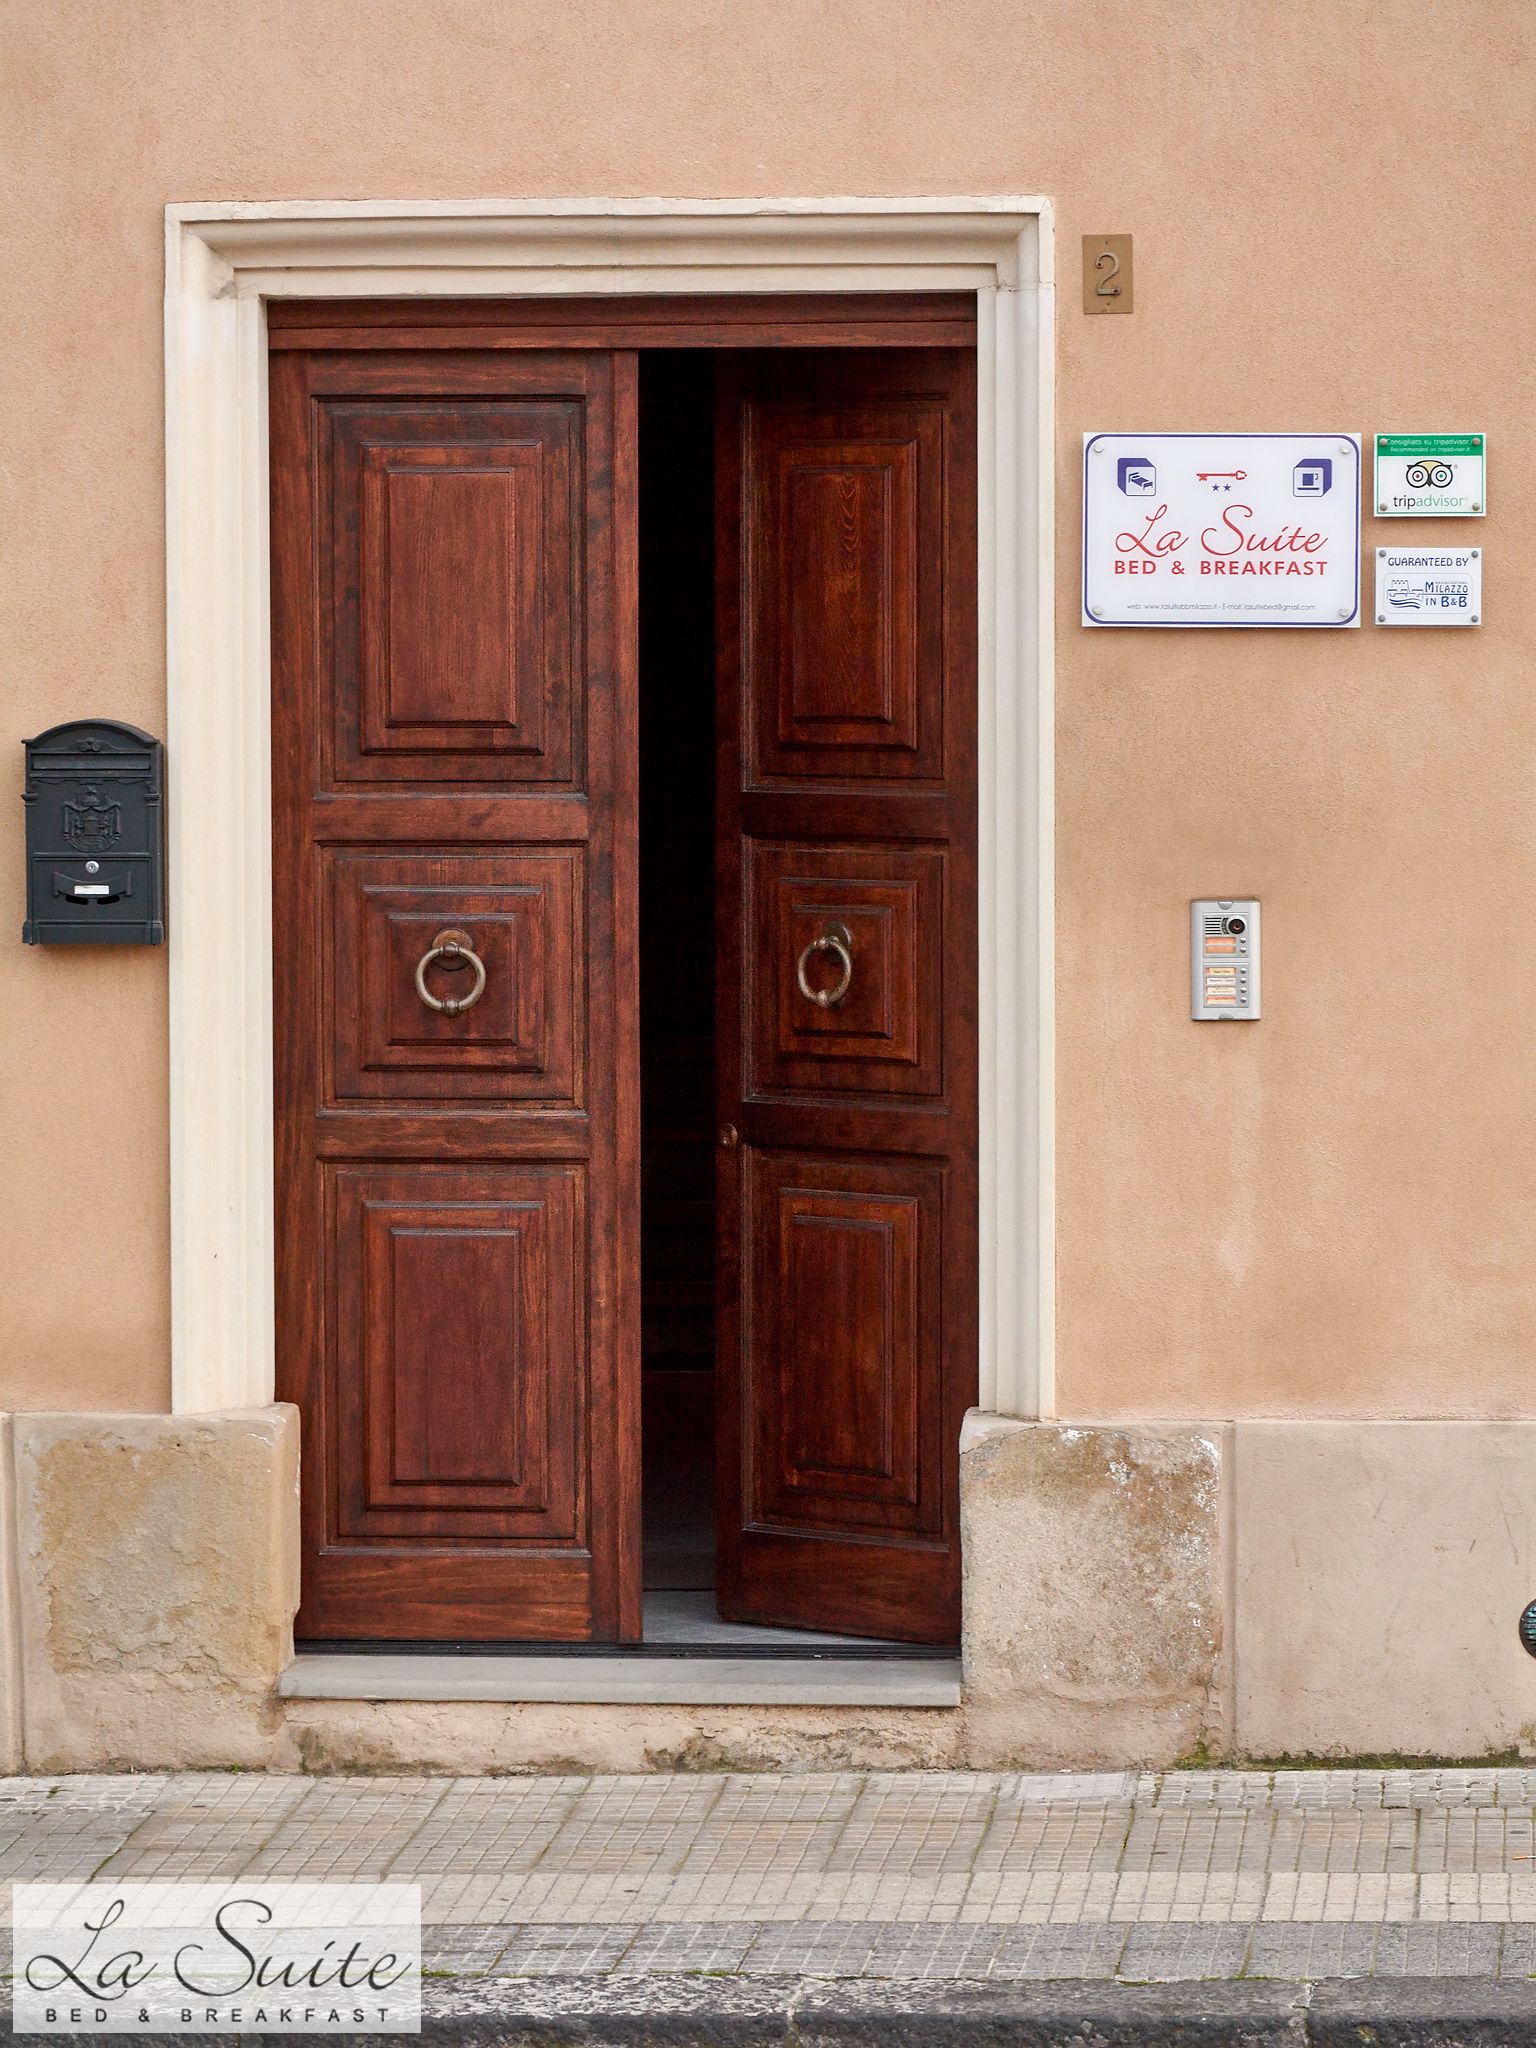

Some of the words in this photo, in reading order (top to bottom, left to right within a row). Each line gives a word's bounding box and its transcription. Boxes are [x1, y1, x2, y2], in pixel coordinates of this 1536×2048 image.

[1095, 251, 1121, 295] 2
[1393, 494, 1464, 510] tripadvisor
[1114, 504, 1190, 557] La
[1200, 504, 1329, 556] Suite
[1114, 560, 1157, 575] BED
[1171, 560, 1186, 575] &
[1200, 560, 1328, 576] BREAKFAST
[1387, 557, 1453, 567] GUARANTEED
[1455, 557, 1469, 567] BY
[1425, 597, 1437, 606] IN
[1441, 596, 1468, 608] B&B
